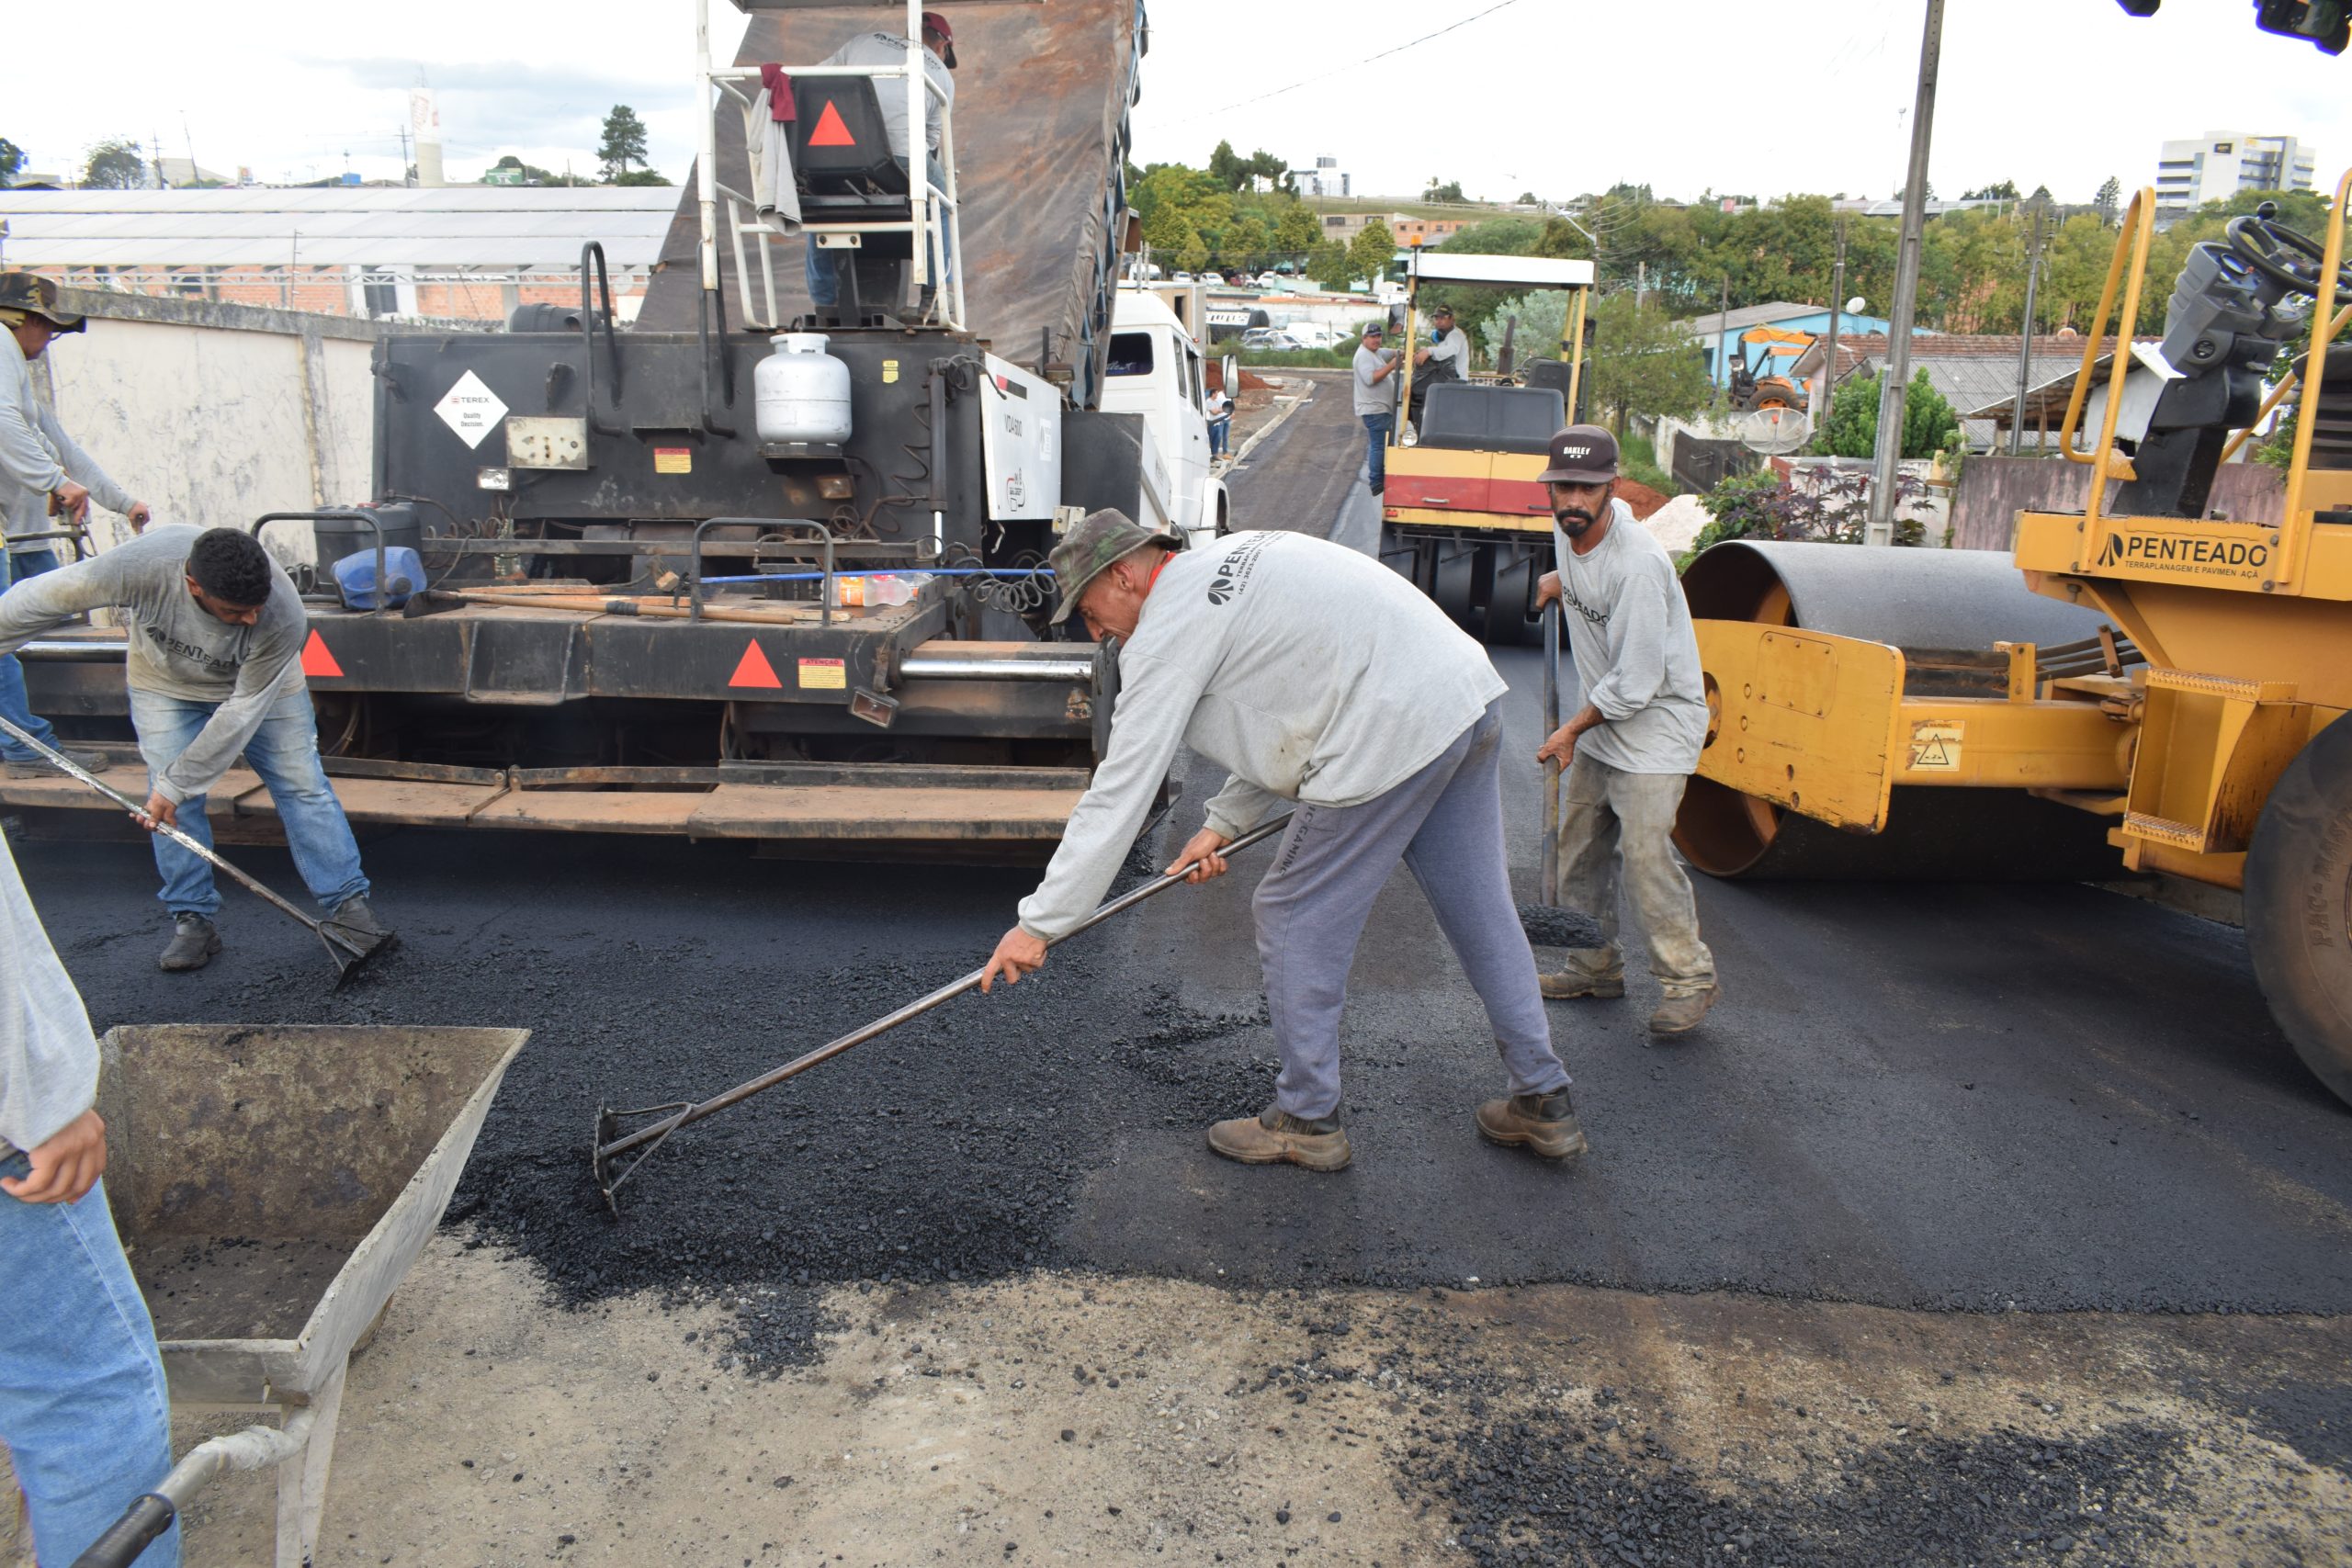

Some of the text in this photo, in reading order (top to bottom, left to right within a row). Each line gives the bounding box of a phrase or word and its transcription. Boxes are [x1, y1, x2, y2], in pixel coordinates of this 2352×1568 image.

[1564, 446, 1591, 455] OAKLEY
[2127, 536, 2268, 567] PENTEADO
[2124, 560, 2193, 573] TERRAPLANAGEM
